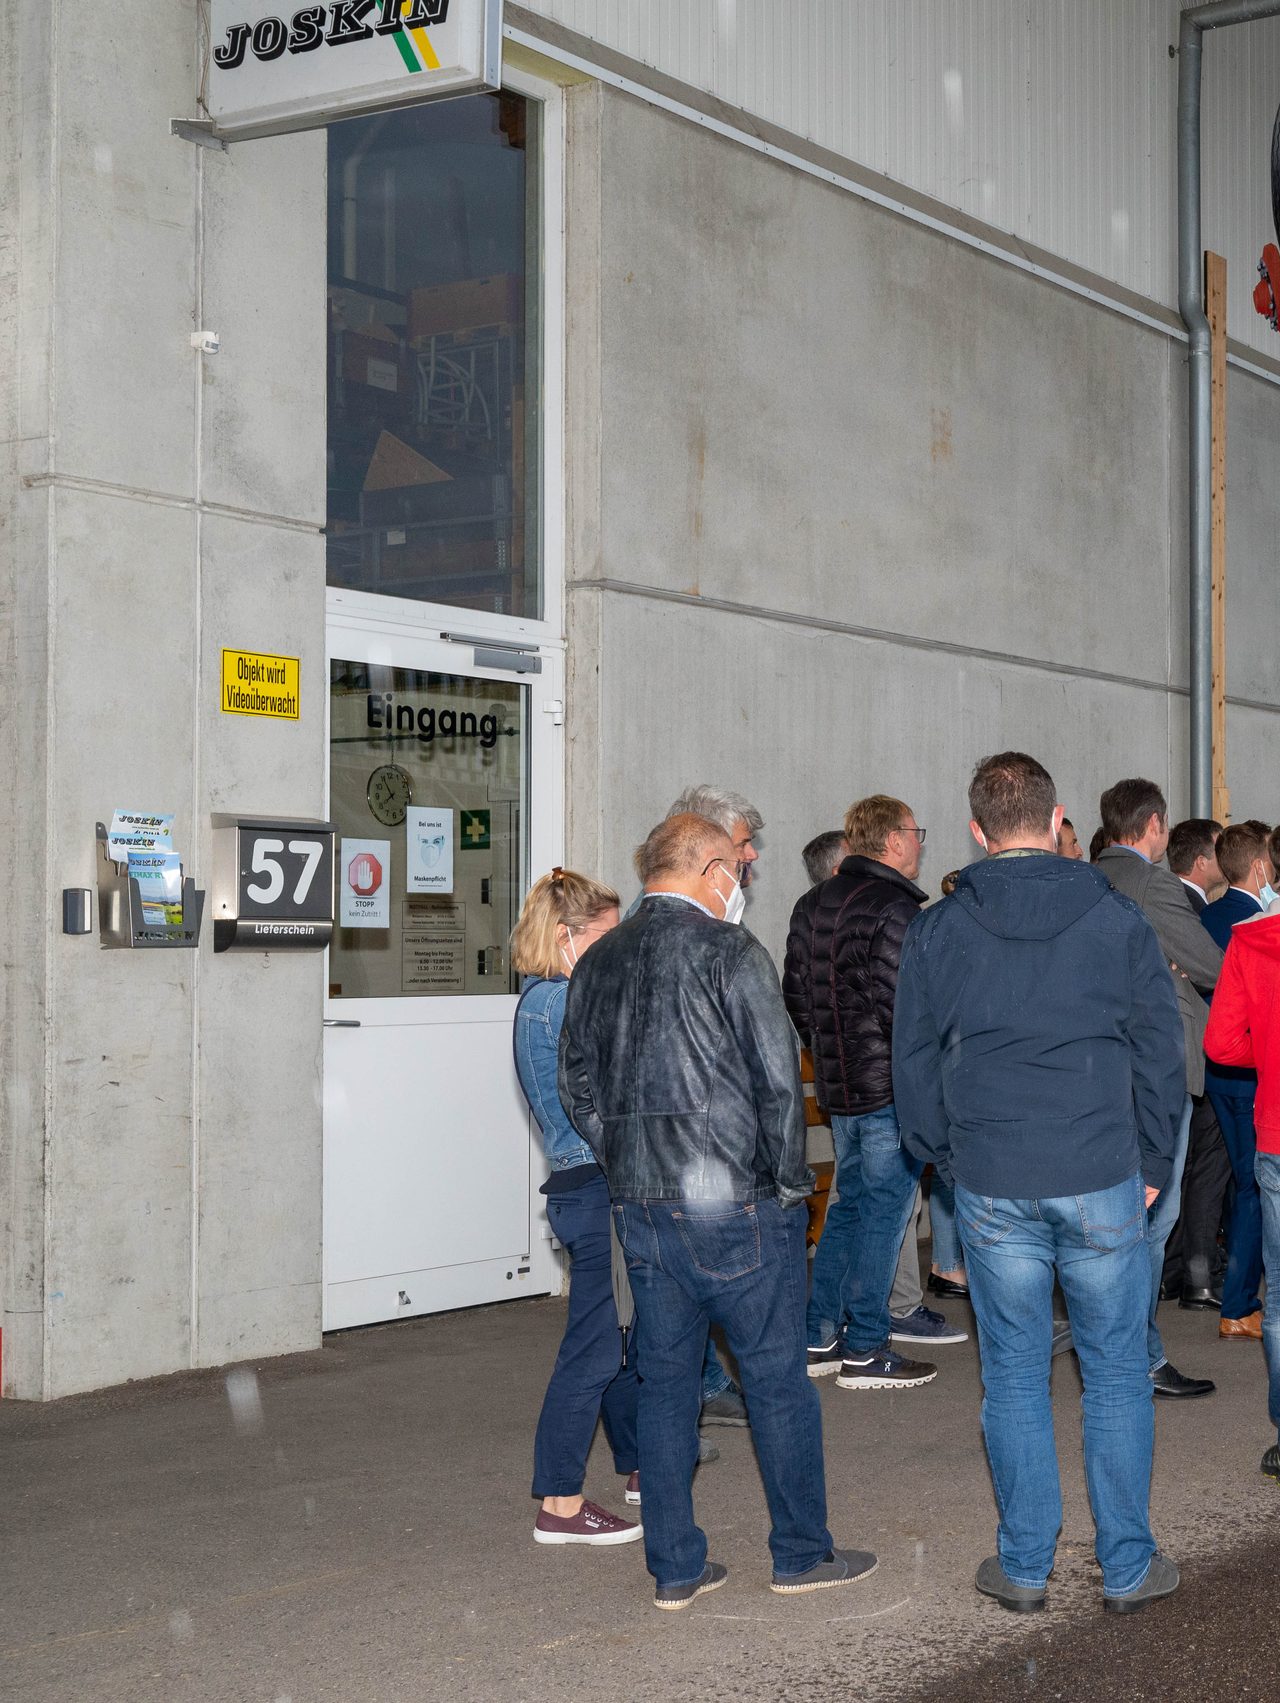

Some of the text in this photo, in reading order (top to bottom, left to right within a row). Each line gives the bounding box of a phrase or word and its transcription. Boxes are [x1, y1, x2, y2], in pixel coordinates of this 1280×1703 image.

[213, 0, 449, 69] JOSKIN
[237, 656, 286, 686] Objekt wird
[226, 684, 296, 715] Videoüberwacht
[367, 693, 498, 748] Eingang
[118, 815, 164, 827] JOSKIN
[111, 837, 156, 848] JOSKIN
[247, 838, 324, 905] 57
[414, 875, 446, 883] Maskenpflicht
[255, 924, 315, 935] Lieferschein
